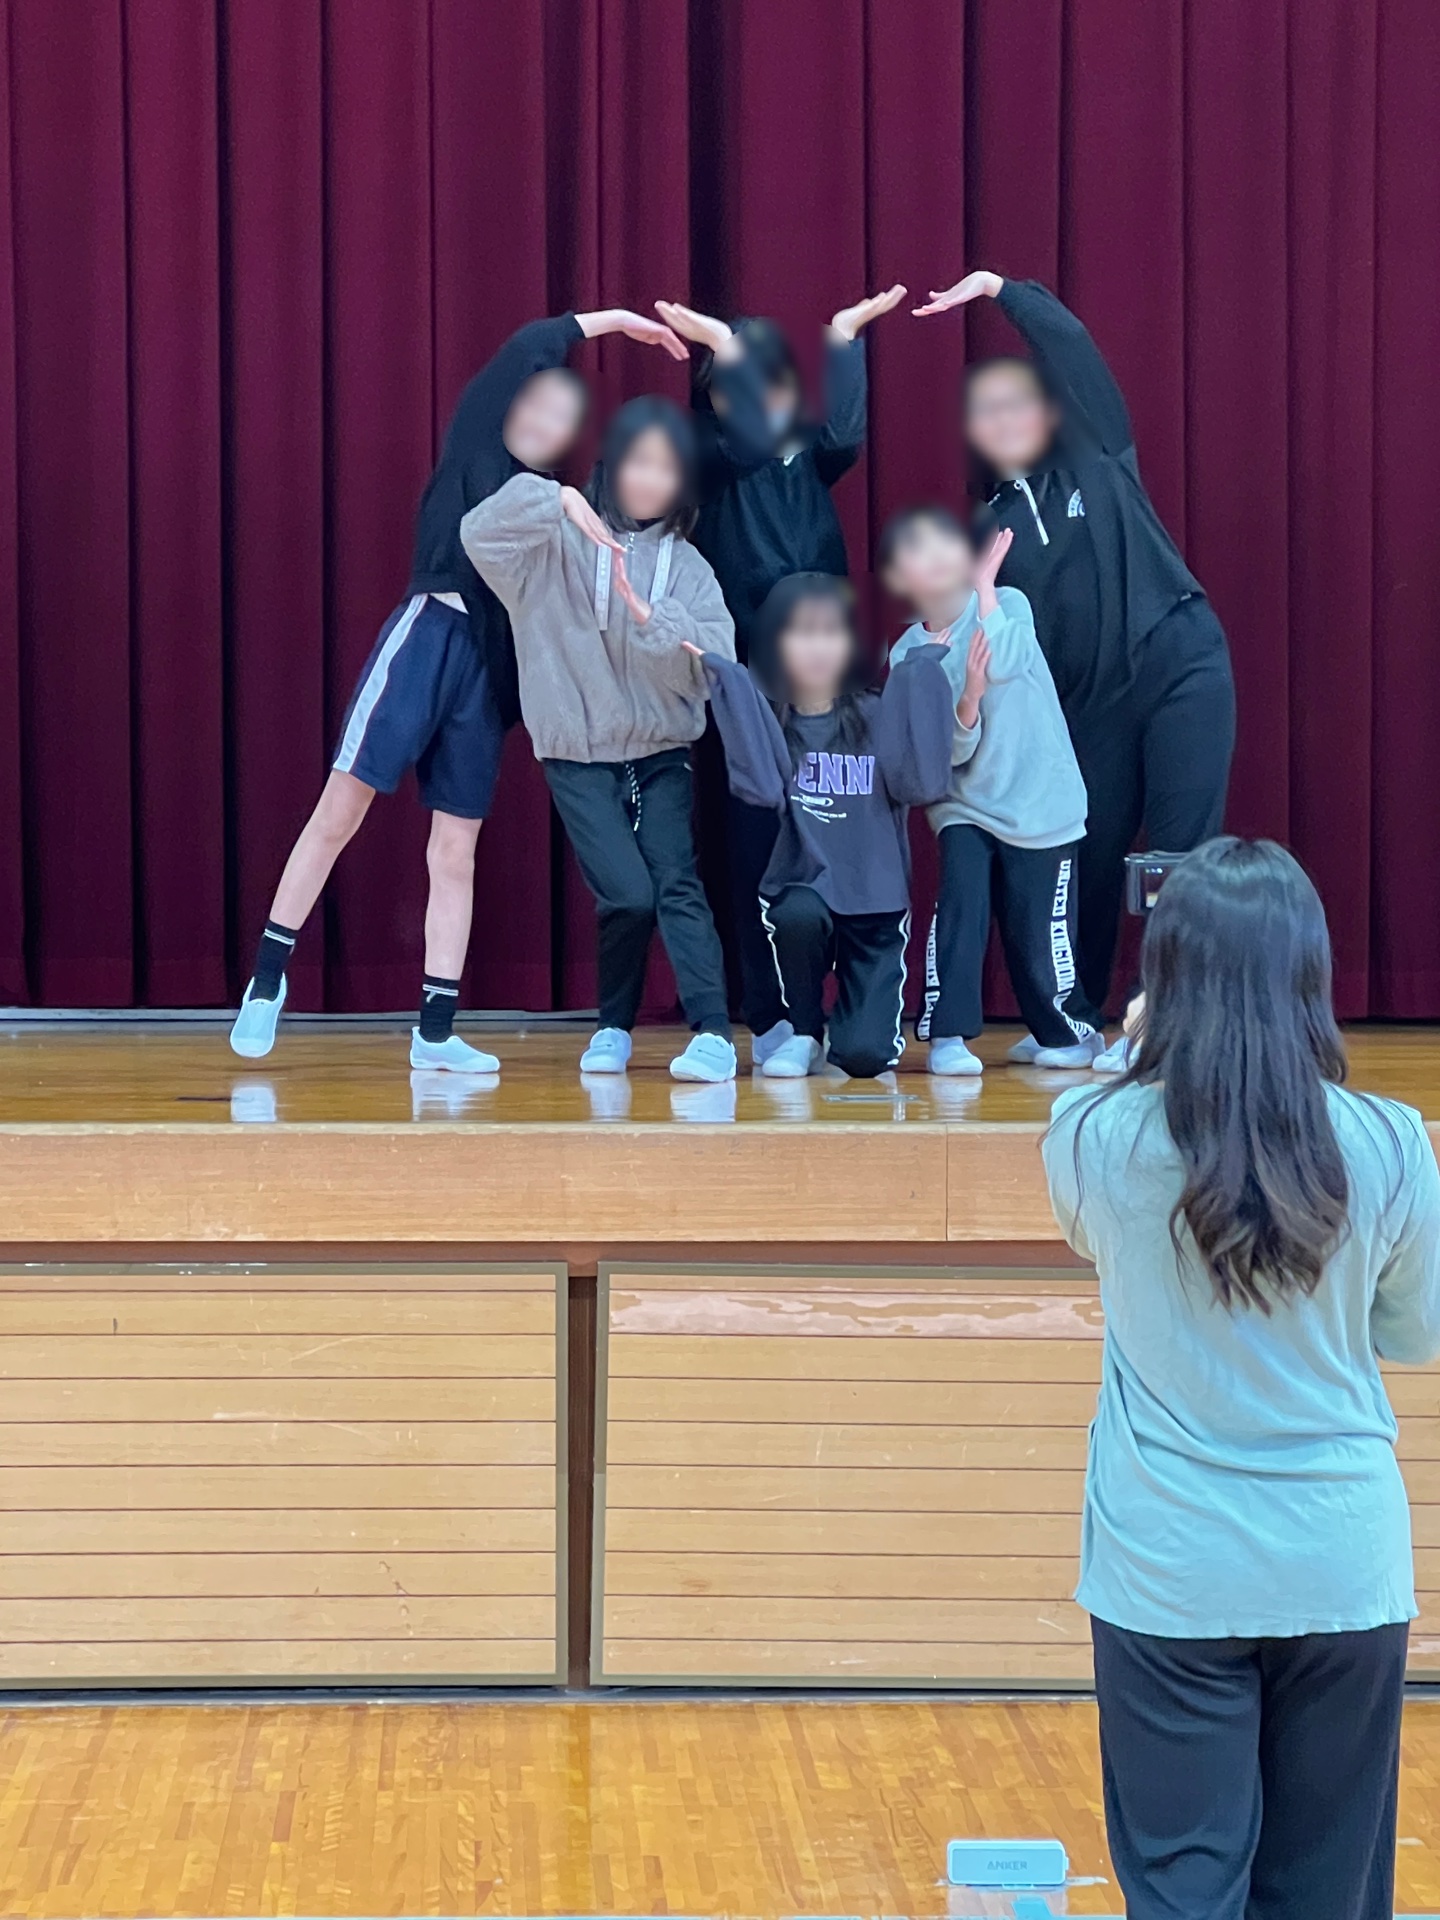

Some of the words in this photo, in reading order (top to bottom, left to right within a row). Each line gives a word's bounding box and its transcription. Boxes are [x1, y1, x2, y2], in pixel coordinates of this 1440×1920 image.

[1052, 859, 1072, 917] UNITED
[1050, 919, 1076, 993] KINGDOM
[987, 1861, 1028, 1871] ANKER
